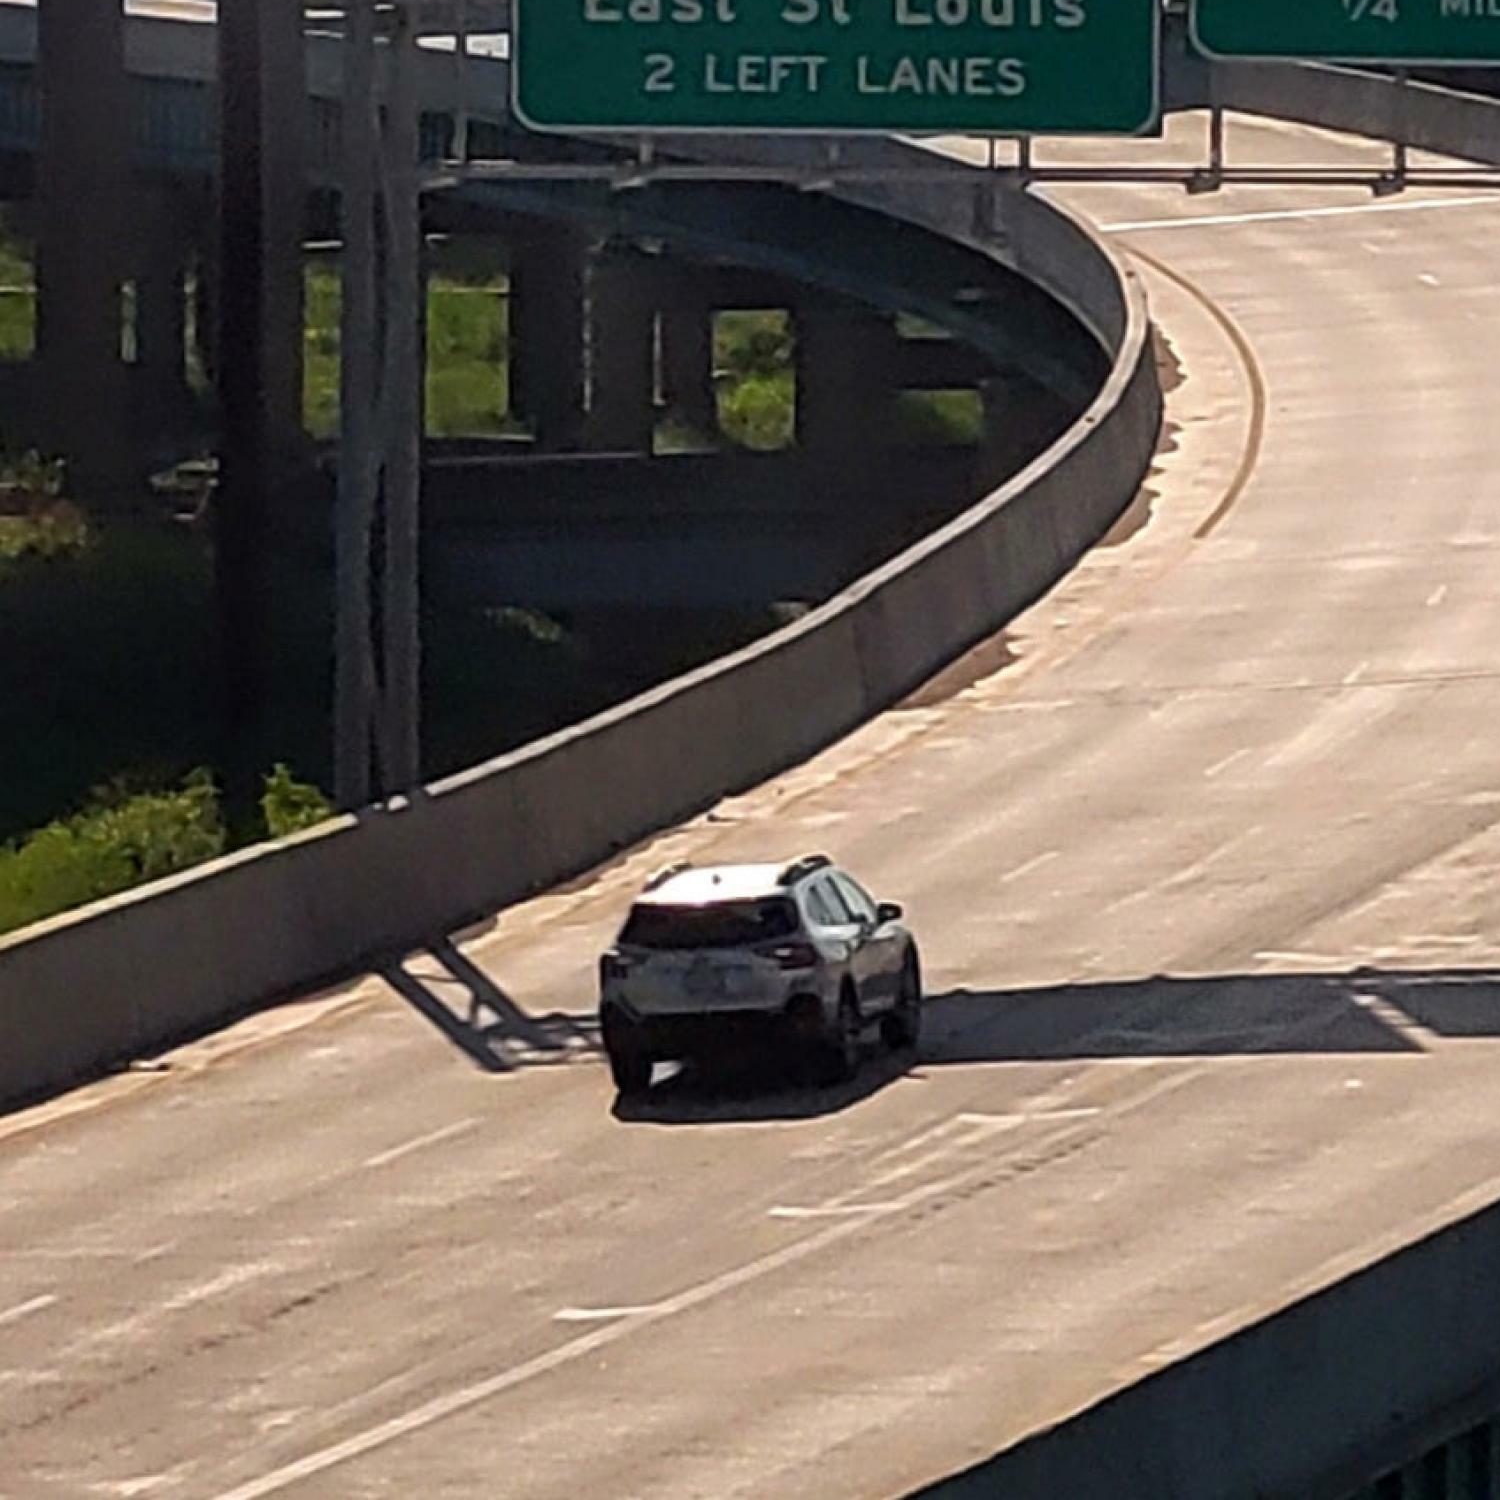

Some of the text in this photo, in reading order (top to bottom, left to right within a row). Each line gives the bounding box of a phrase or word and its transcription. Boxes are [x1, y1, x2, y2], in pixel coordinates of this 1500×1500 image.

[644, 53, 1027, 97] 2 LEFT LANES
